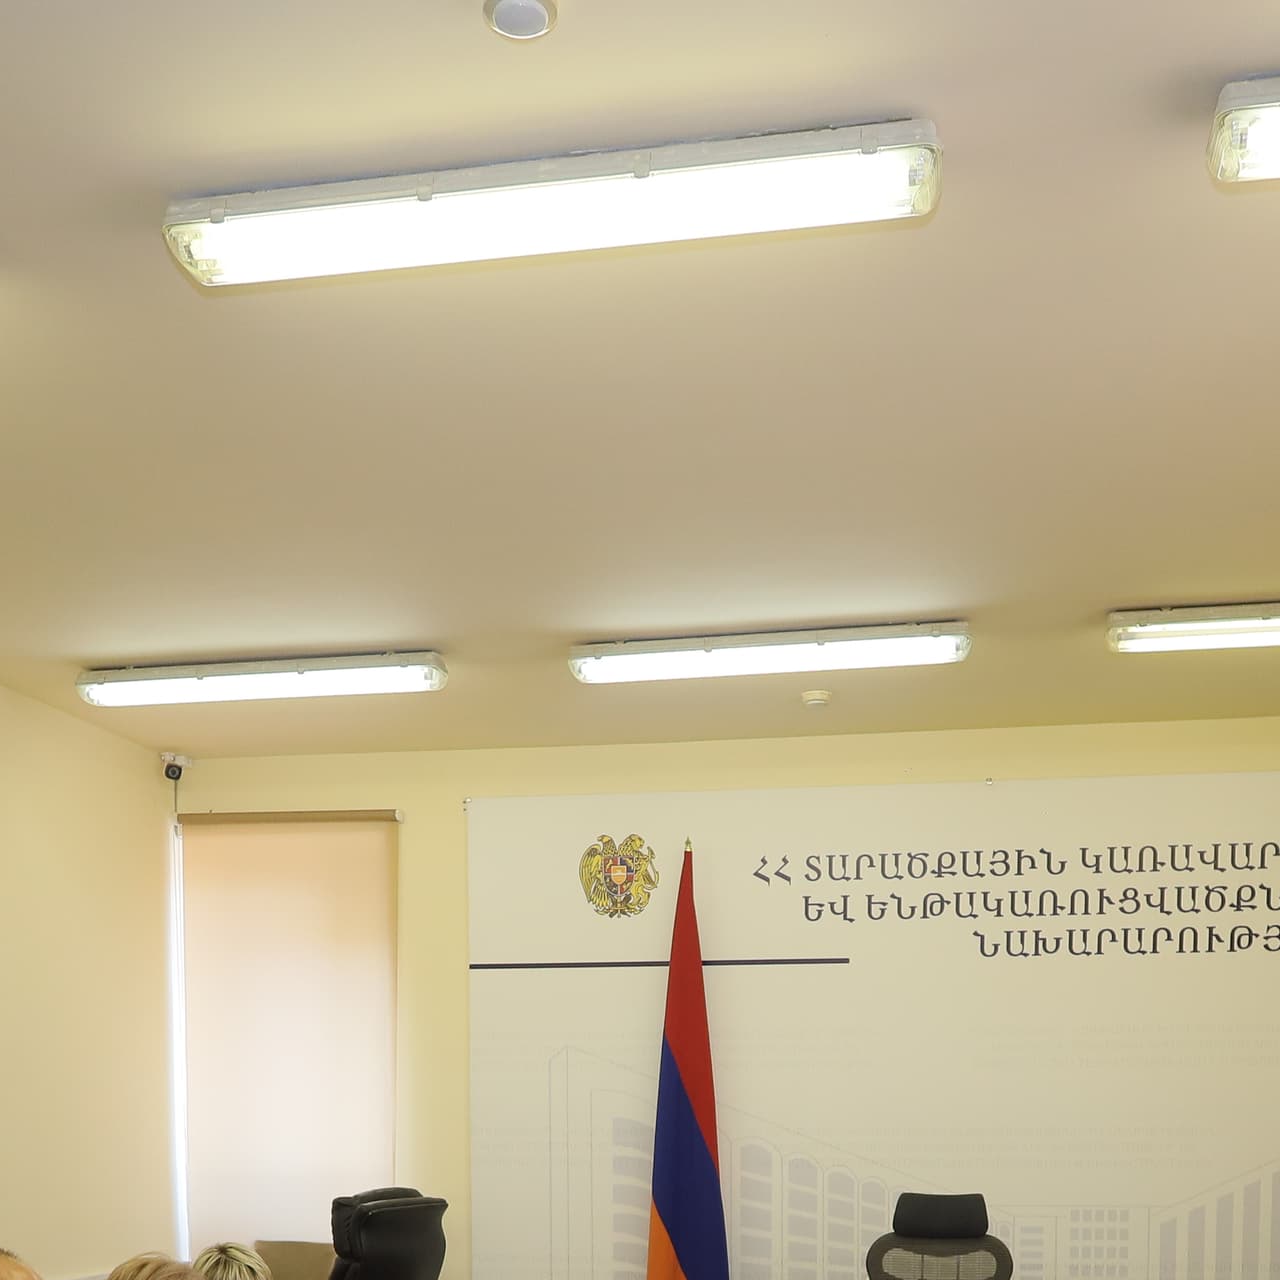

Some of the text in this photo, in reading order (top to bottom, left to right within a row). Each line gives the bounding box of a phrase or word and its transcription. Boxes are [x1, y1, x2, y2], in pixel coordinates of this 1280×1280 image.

[752, 855, 792, 885] ՀՀ
[804, 847, 1068, 882] ՏԱՐԱԾՔԱՅԻՆ
[802, 894, 855, 923] ԵՎ
